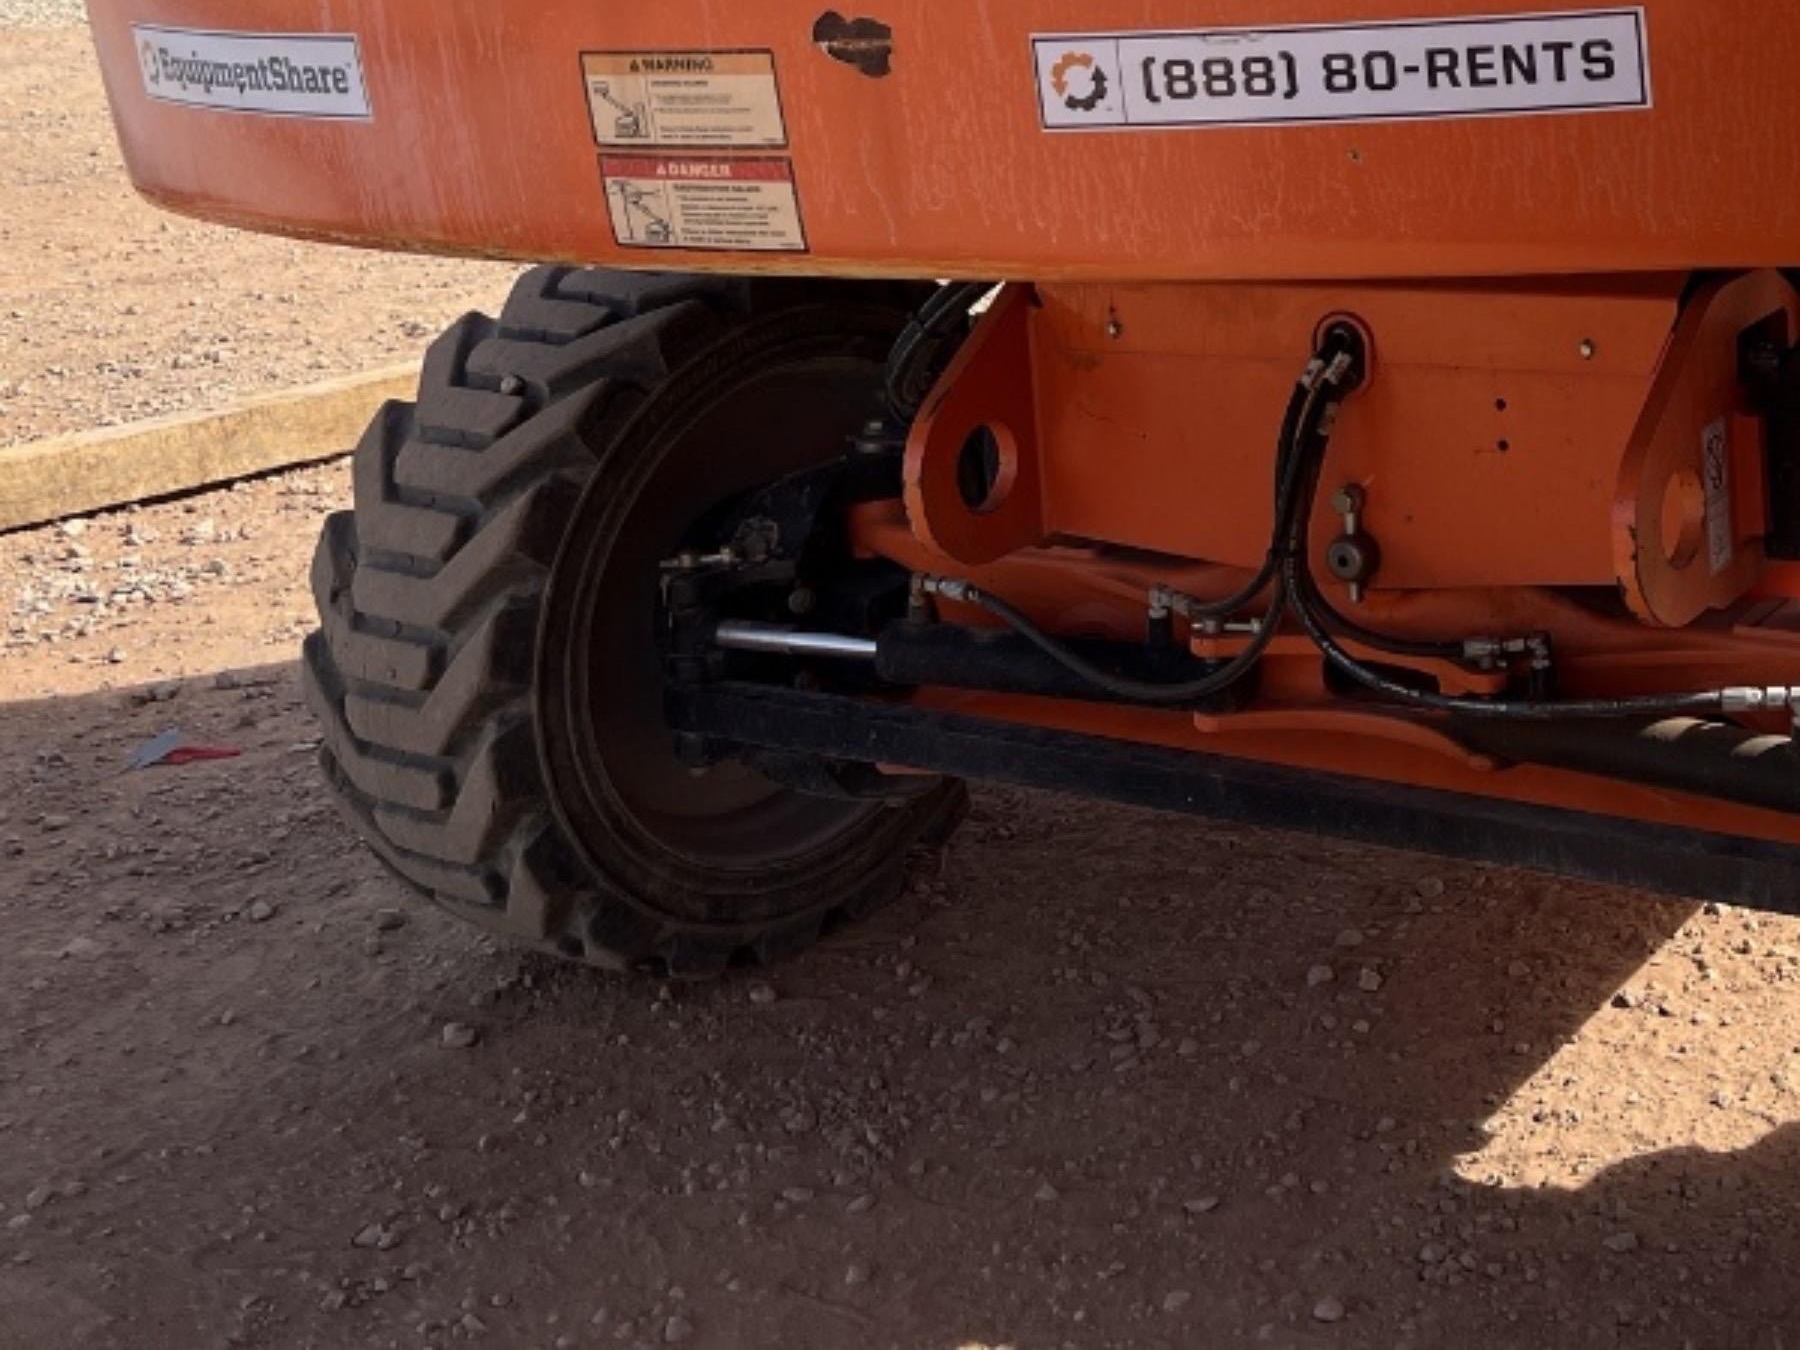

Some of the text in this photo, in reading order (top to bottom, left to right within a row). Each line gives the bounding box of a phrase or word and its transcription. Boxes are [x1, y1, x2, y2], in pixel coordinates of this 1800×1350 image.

[158, 46, 350, 96] EquipmentShare
[642, 57, 715, 72] WARNING
[1141, 38, 1617, 104] (888) 80-RENTS
[668, 163, 733, 179] DANGER
